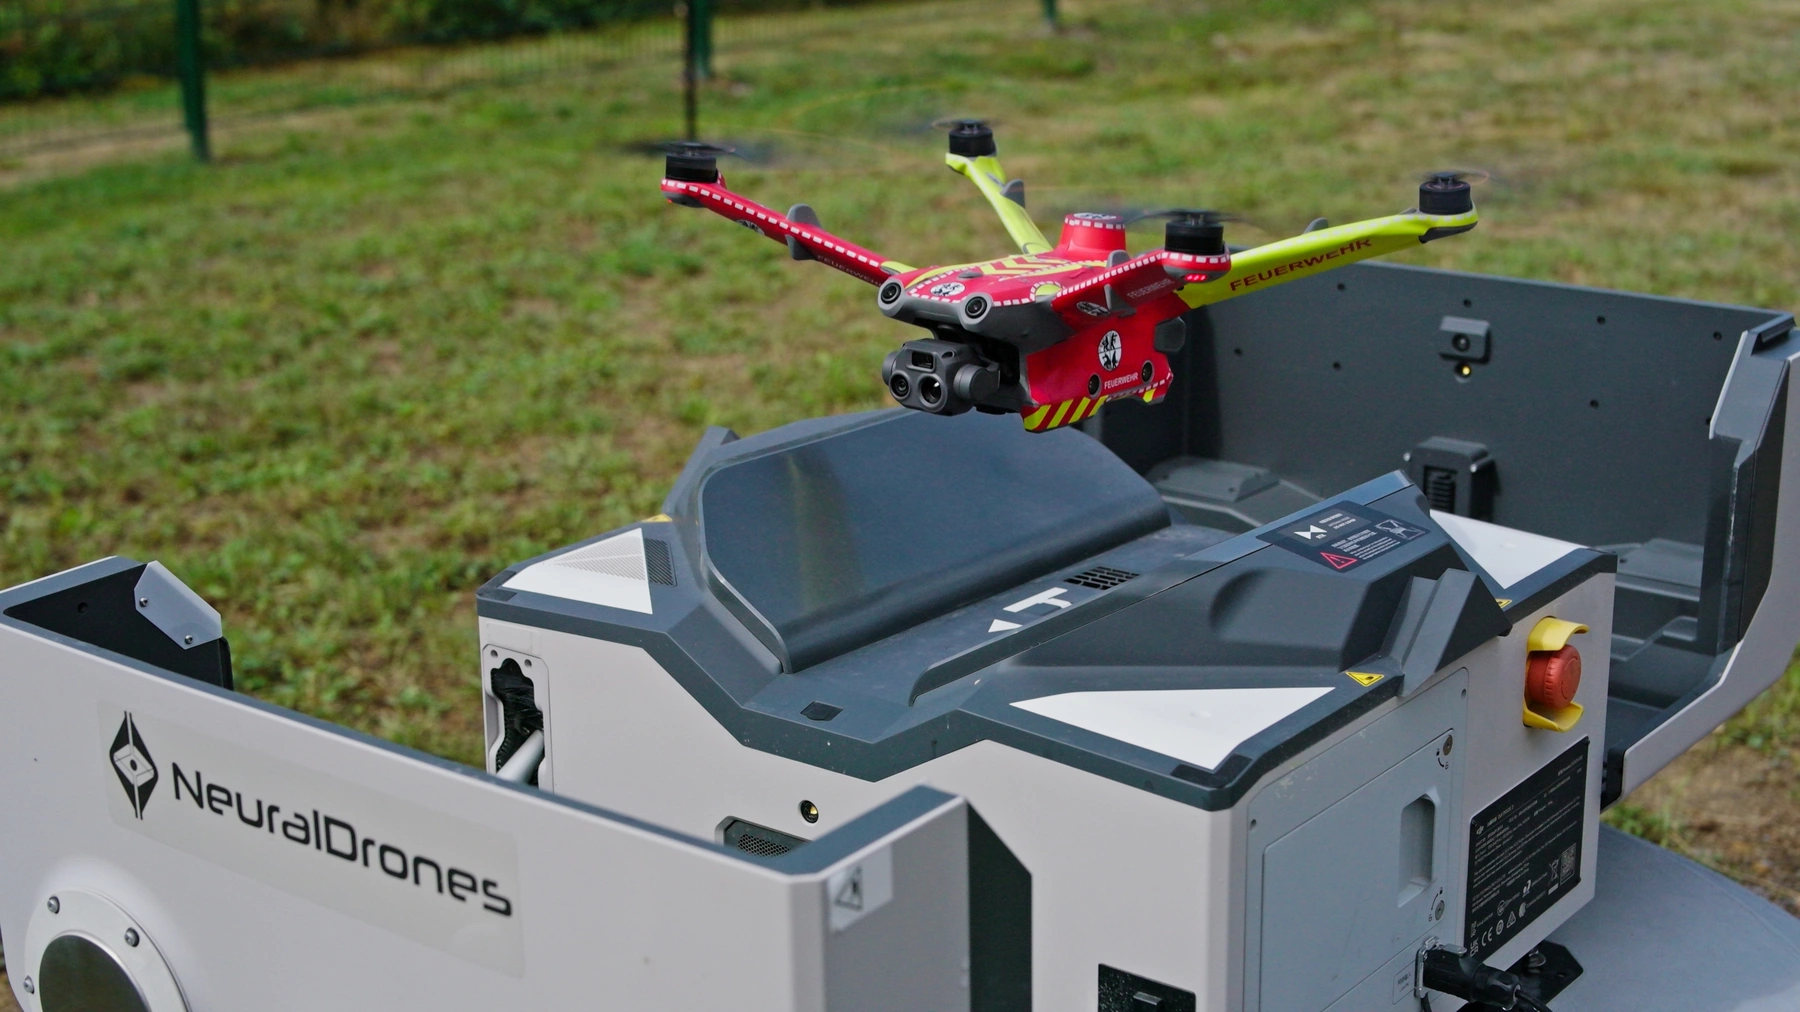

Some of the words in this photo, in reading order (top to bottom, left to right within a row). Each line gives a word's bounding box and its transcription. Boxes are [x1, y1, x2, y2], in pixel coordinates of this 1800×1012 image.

[817, 254, 882, 288] FEUERWEH
[1229, 238, 1372, 291] FEUERWEHR
[1104, 372, 1139, 390] FEUERWEHR
[171, 761, 513, 917] NeuralDrones
